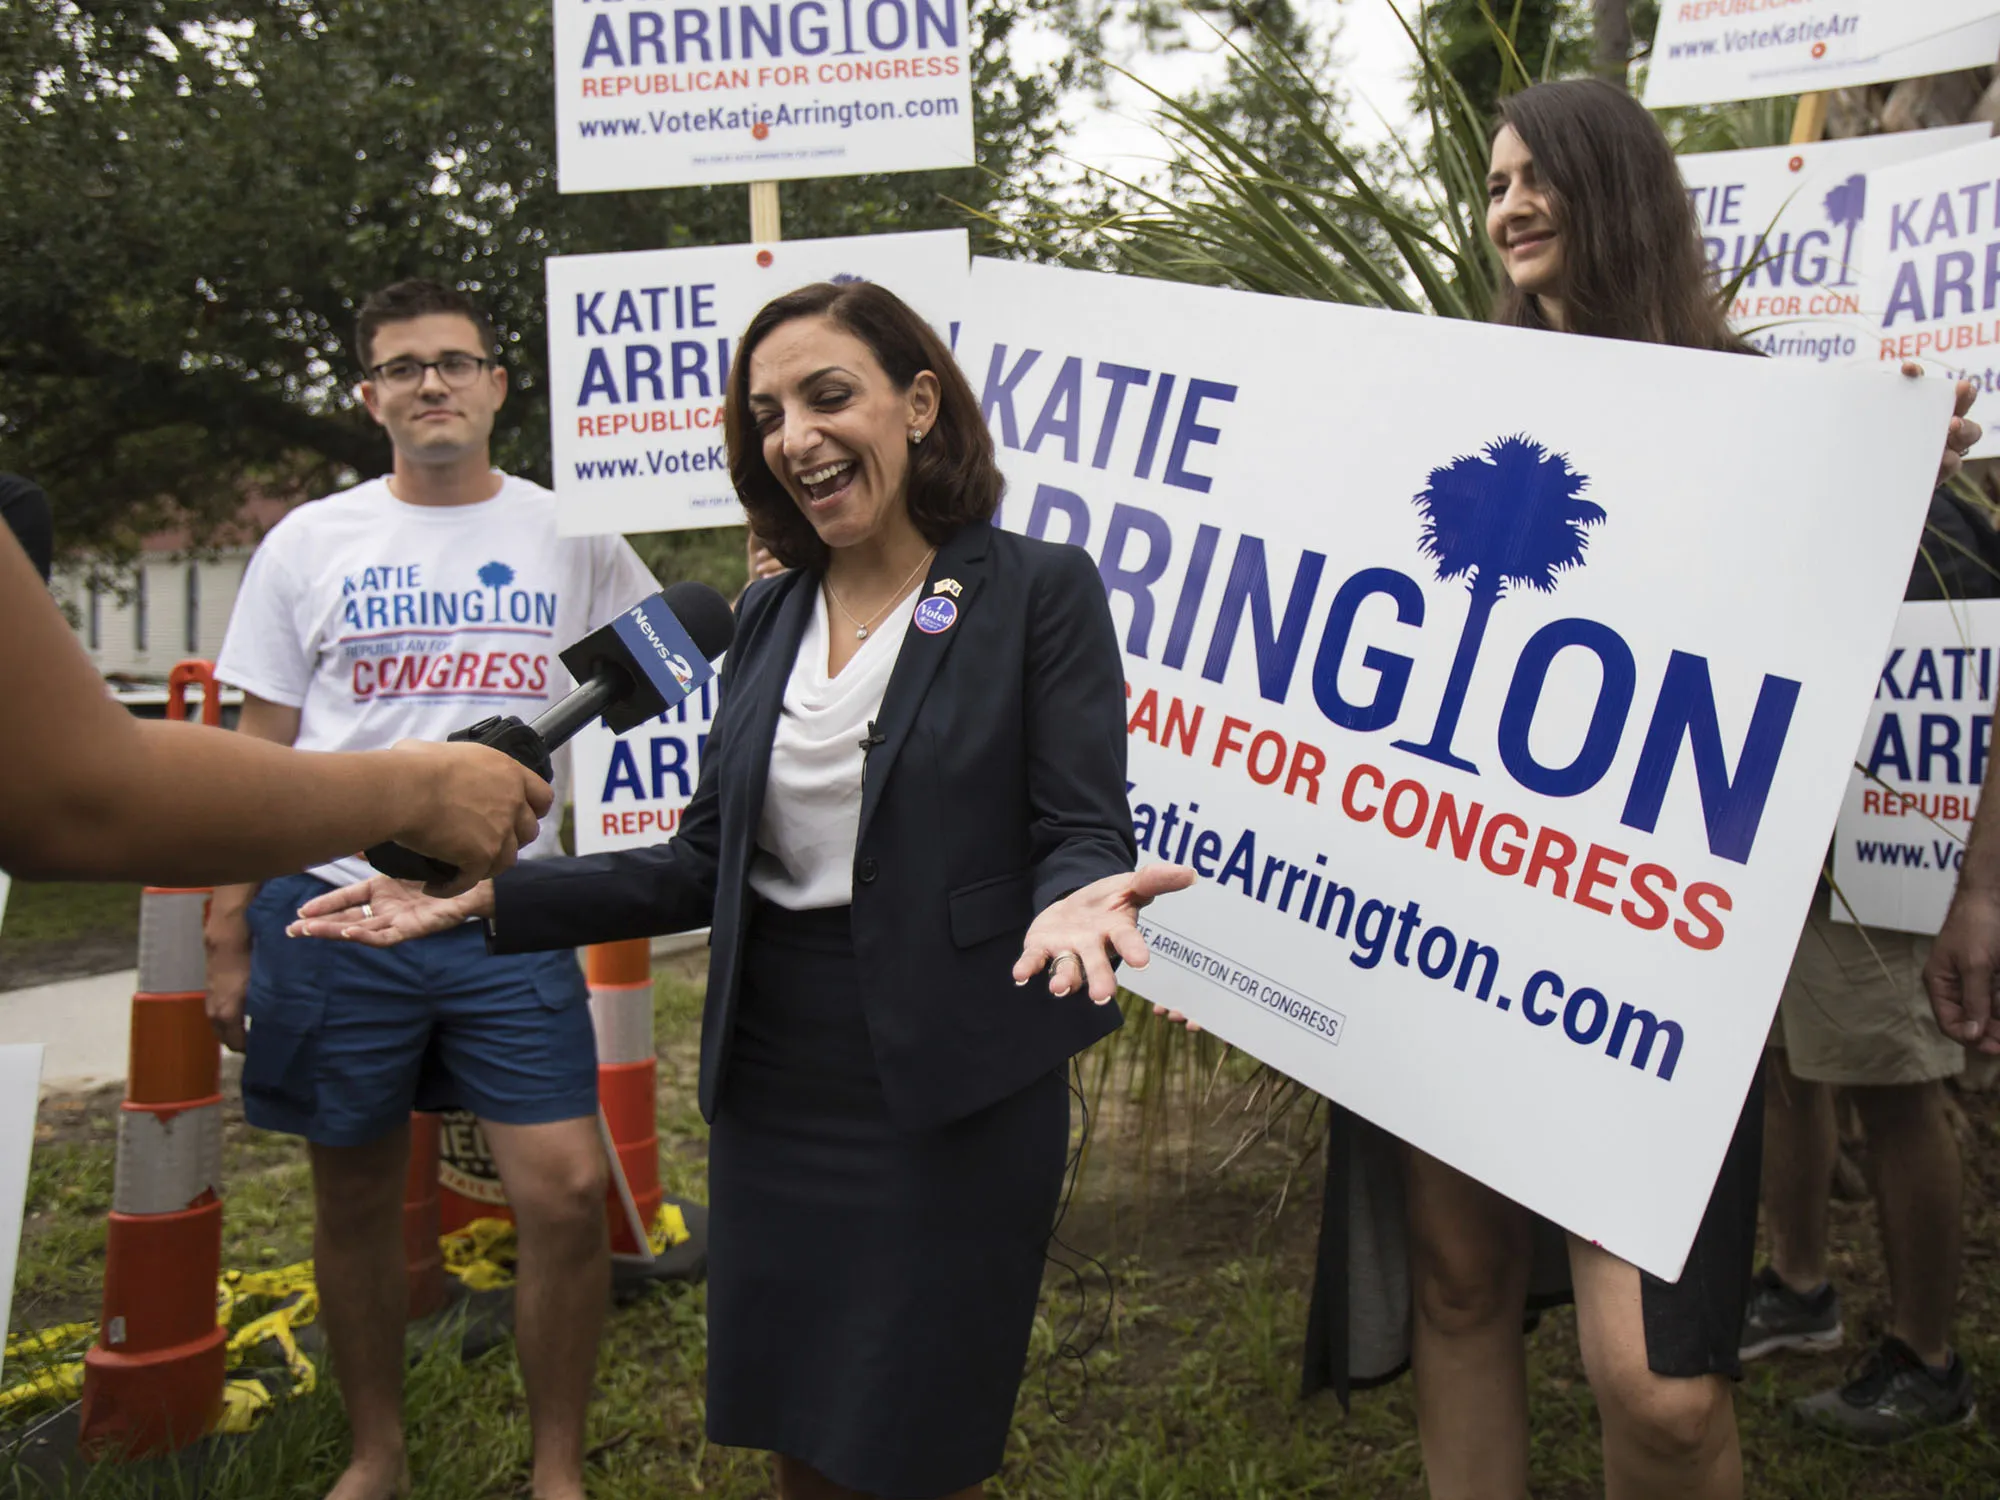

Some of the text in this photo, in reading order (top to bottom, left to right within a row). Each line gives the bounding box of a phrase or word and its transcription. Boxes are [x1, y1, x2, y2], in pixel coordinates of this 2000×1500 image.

[581, 0, 958, 69] ARRINGTON
[582, 56, 960, 98] REPUBLICAN FOR CONGRESS
[579, 97, 959, 138] www.VoteKatieArrington.com
[1890, 178, 2000, 252] KATI
[575, 283, 718, 337] KATIE
[1756, 297, 1801, 316] FOR
[1880, 320, 2000, 360] REPUBLI
[981, 342, 1239, 494] KATIE
[343, 564, 421, 596] KATIE
[345, 561, 557, 630] ARRINGTON
[631, 607, 670, 659] News
[920, 604, 953, 625] Voted
[352, 652, 549, 696] CONGRESS
[1876, 647, 2000, 700] KATI
[1863, 790, 1974, 822] REPUBL
[1211, 715, 1327, 804] FOR
[1341, 763, 1734, 952] CONGRESS
[1127, 780, 1685, 1082] atieArrington.com
[1151, 933, 1230, 982] ARRINGTON
[1229, 971, 1260, 998] FOR
[1260, 986, 1339, 1037] CONGRESS
